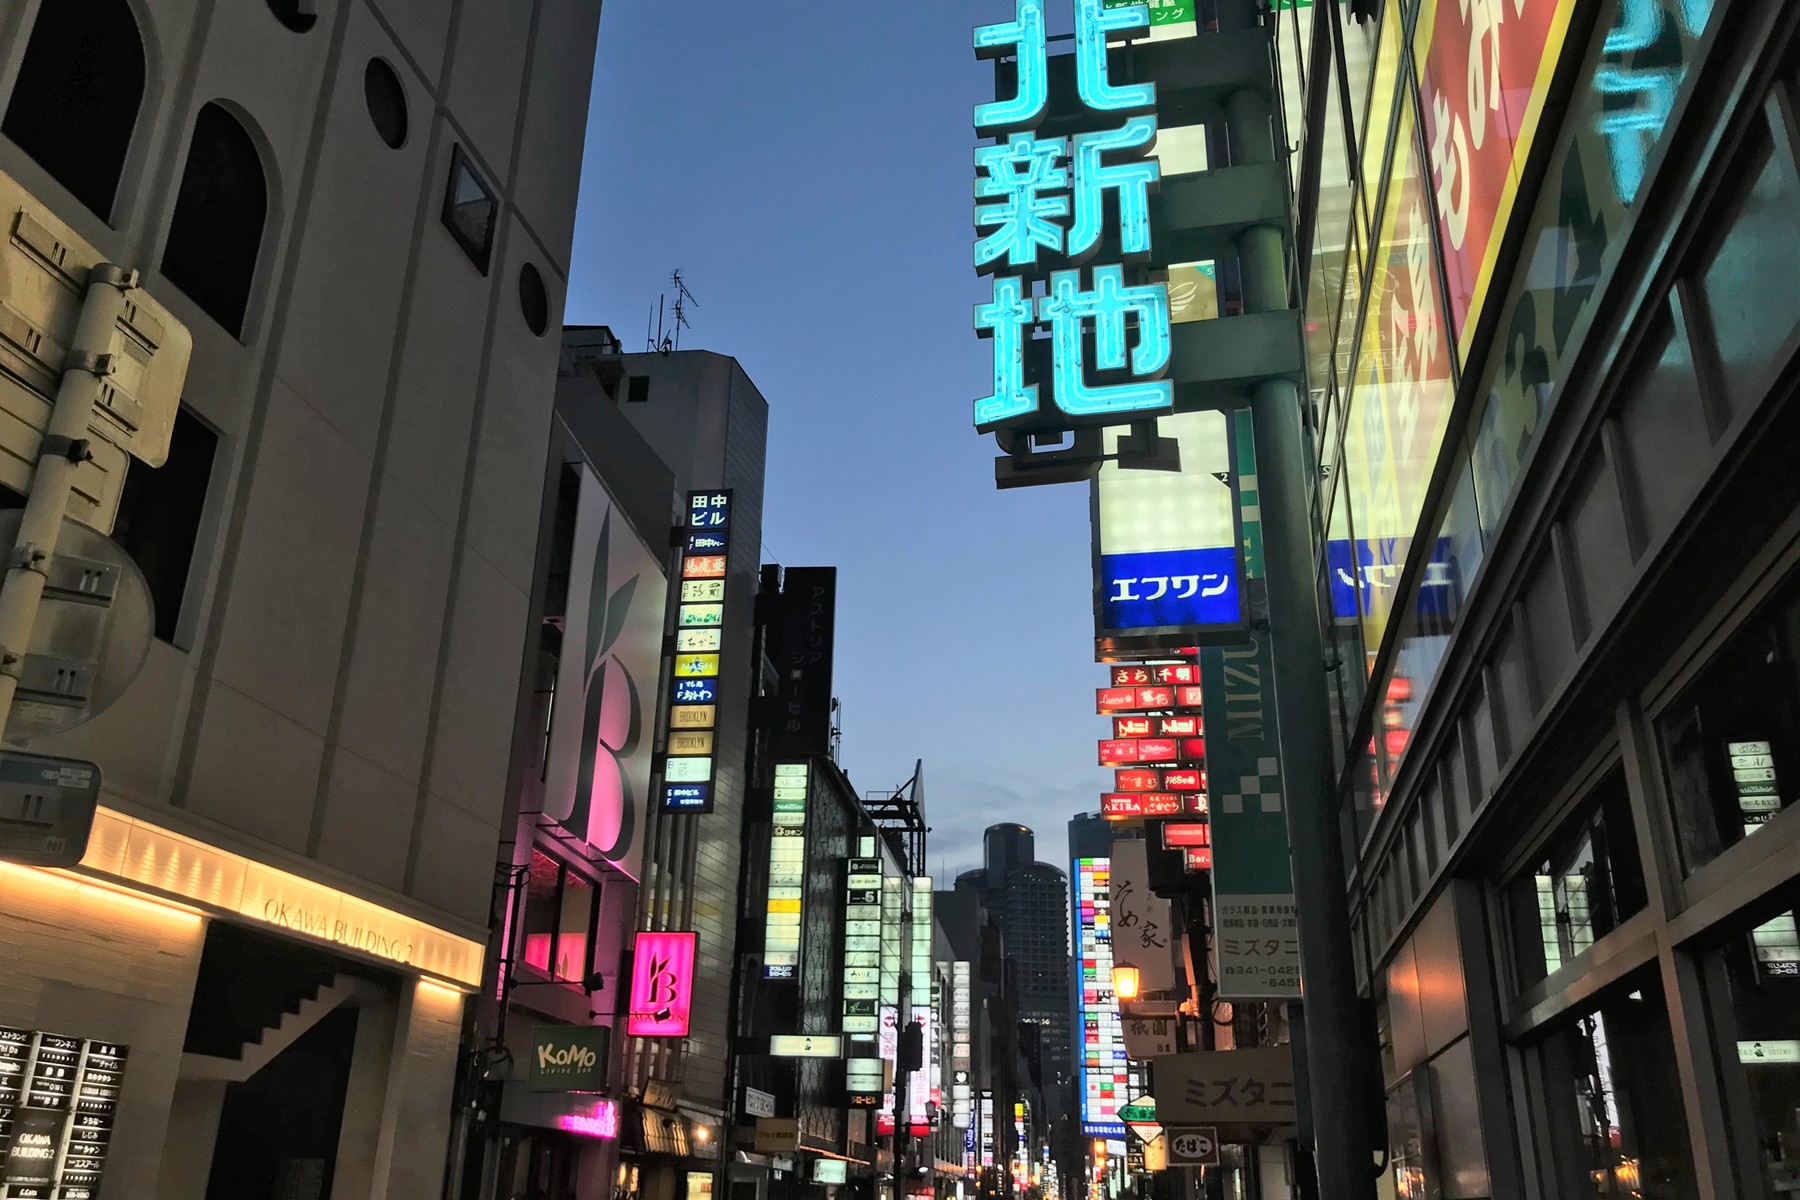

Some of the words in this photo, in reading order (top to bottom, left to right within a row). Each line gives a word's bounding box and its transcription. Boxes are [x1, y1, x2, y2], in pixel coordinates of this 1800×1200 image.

[973, 0, 1174, 426] 北新地
[692, 494, 728, 508] 田中
[691, 511, 726, 526] ビル
[1110, 573, 1229, 602] エフワン
[681, 661, 713, 671] NASH
[1117, 669, 1148, 683] さち
[679, 711, 708, 723] BROOKLYN
[677, 737, 705, 749] BROOKLYN
[1103, 803, 1141, 811] AKIRA
[264, 897, 329, 940] OKAWA
[332, 918, 401, 962] BUILDING
[1224, 939, 1299, 956] ミズタニ
[1184, 1077, 1295, 1108] ミズタニ
[20, 1132, 51, 1146] OKAWA
[1175, 1138, 1208, 1154] たばこ
